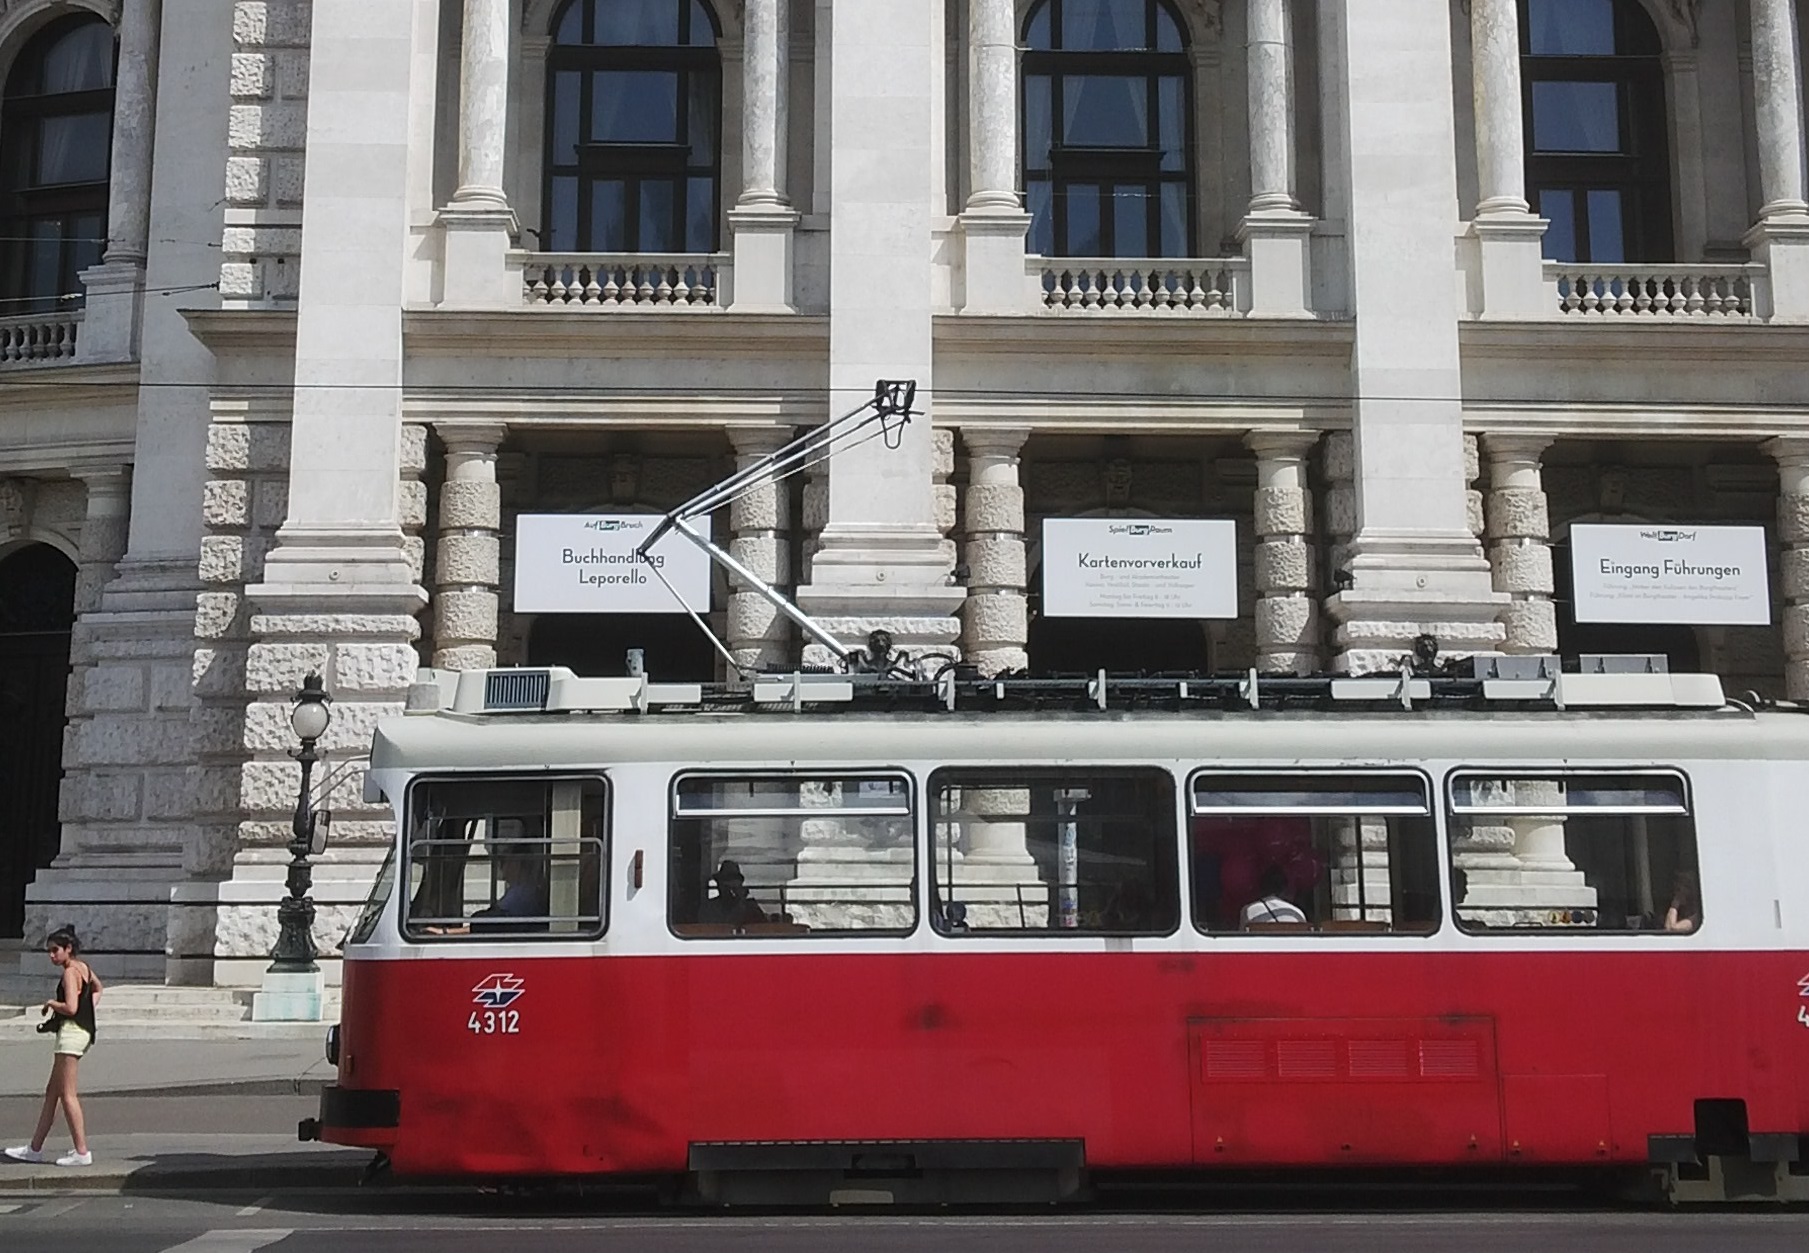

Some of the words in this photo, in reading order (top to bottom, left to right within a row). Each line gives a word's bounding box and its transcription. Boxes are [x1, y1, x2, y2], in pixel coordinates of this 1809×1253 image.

[1078, 553, 1202, 569] Kartenvorverkauf
[1600, 558, 1660, 579] Eingang
[1664, 559, 1741, 580] Führungen
[579, 569, 647, 588] Leporello
[468, 1010, 520, 1034] 4312
